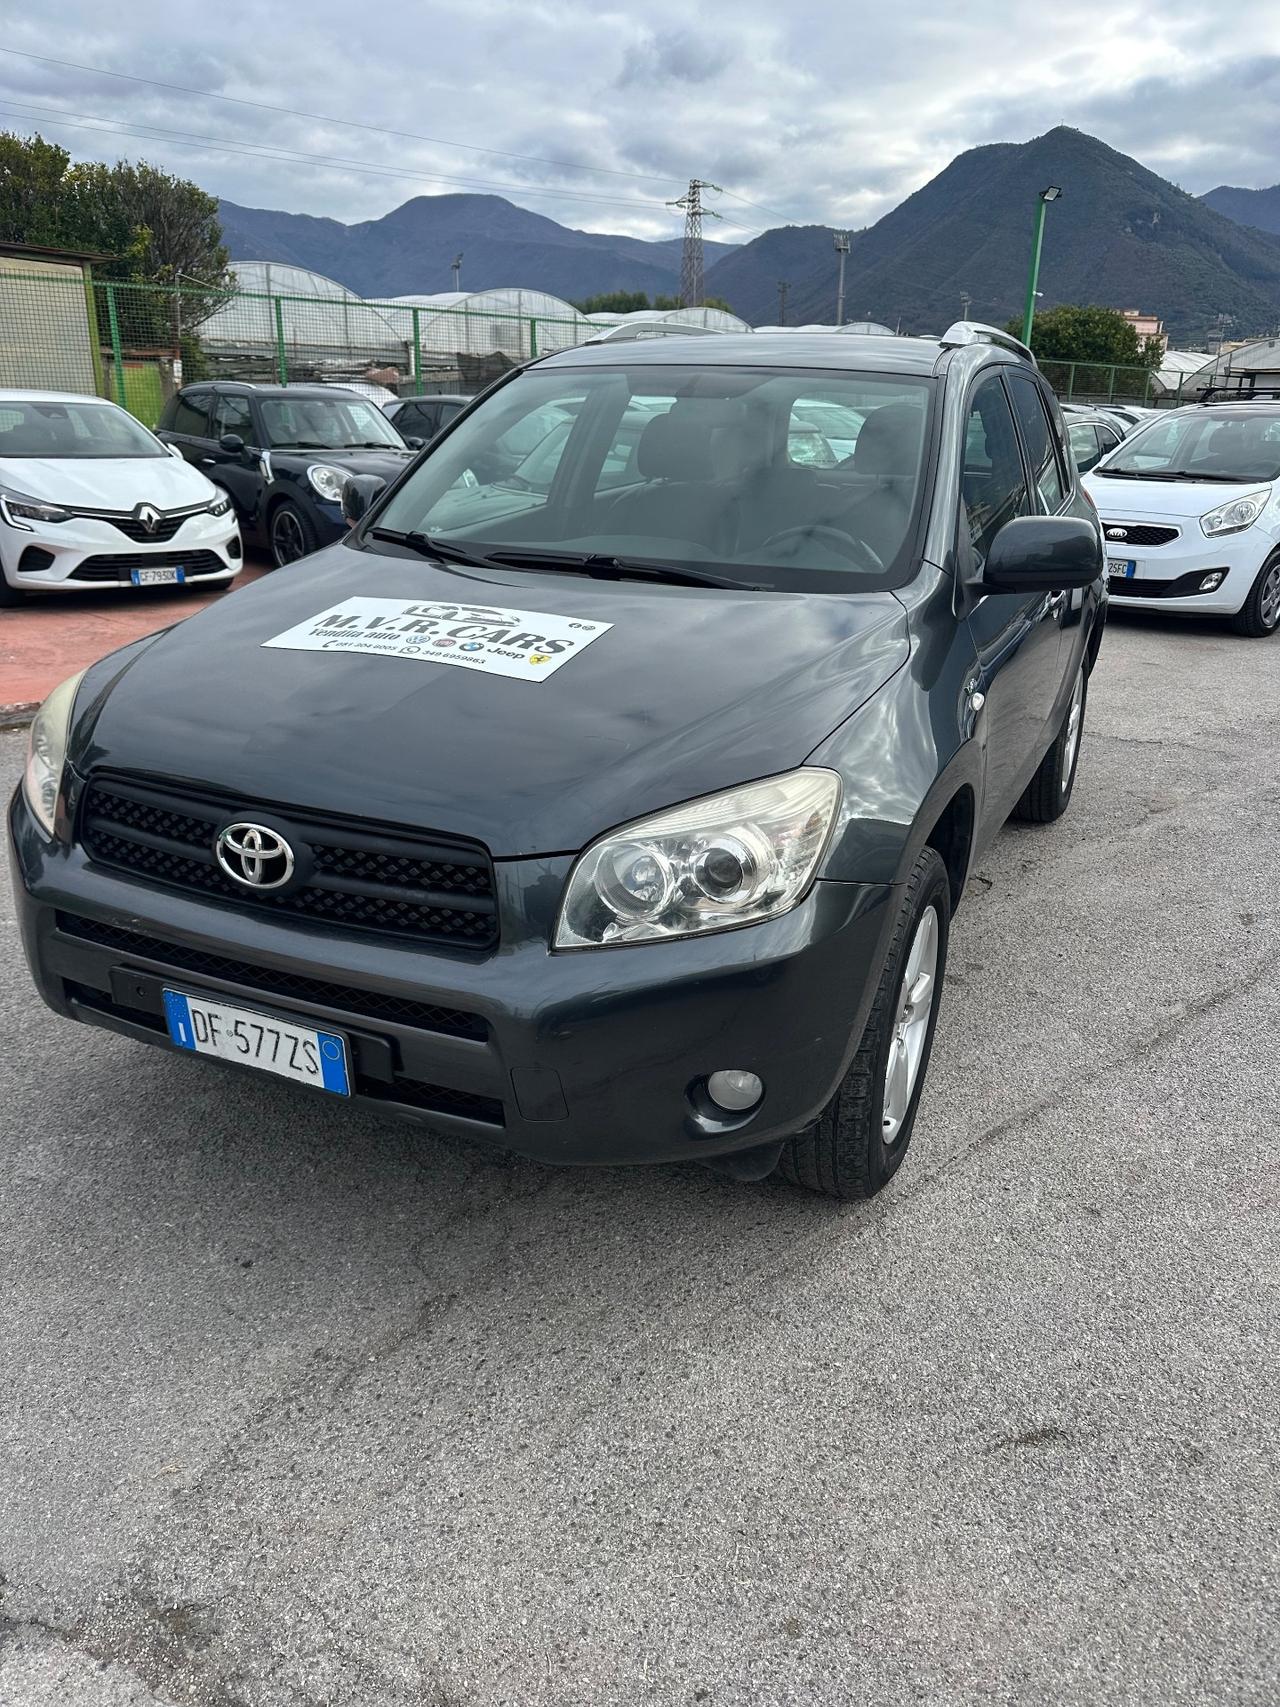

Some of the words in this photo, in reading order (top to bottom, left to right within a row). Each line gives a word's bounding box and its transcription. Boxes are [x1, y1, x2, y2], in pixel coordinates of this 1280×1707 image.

[308, 628, 364, 638] Vendita
[364, 631, 401, 640] auto
[487, 647, 525, 660] Jeep
[191, 1008, 222, 1047] DF
[234, 1020, 320, 1075] 577ZS
